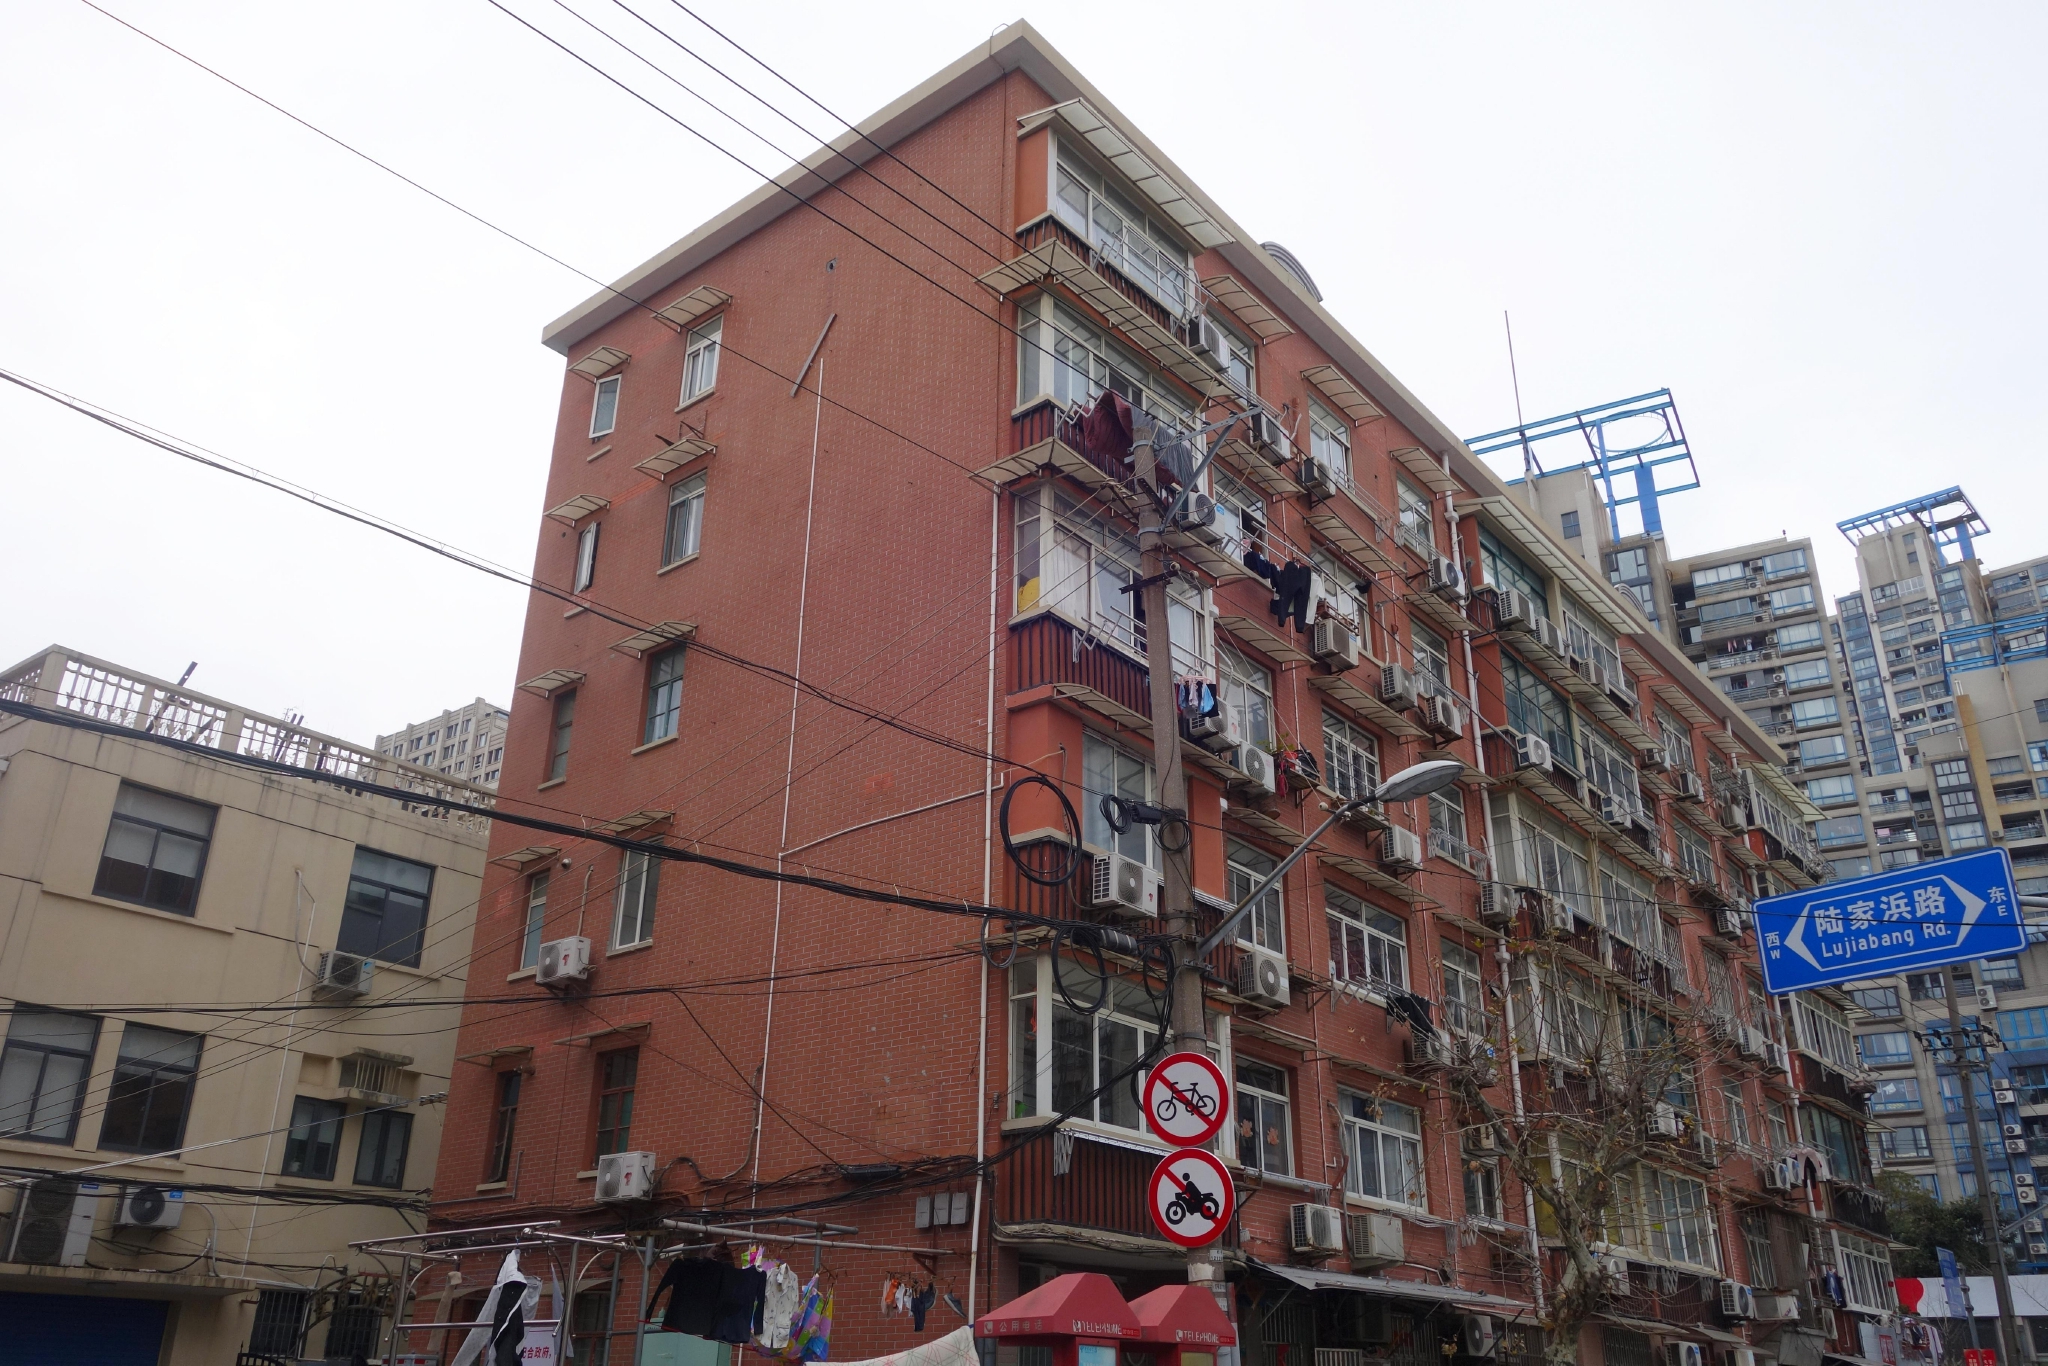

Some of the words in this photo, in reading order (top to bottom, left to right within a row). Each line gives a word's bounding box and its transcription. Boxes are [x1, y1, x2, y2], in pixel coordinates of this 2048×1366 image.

[1987, 886, 2008, 904] 东
[1814, 886, 1946, 937] 陆家浜路
[1997, 905, 2008, 916] E
[1764, 931, 1780, 948] 西
[1821, 929, 1914, 958] Lujiabang
[1922, 920, 1952, 939] Rd.
[1770, 949, 1780, 959] W
[999, 1319, 1043, 1333] 公用电话
[1183, 1330, 1220, 1344] TELEPHONE
